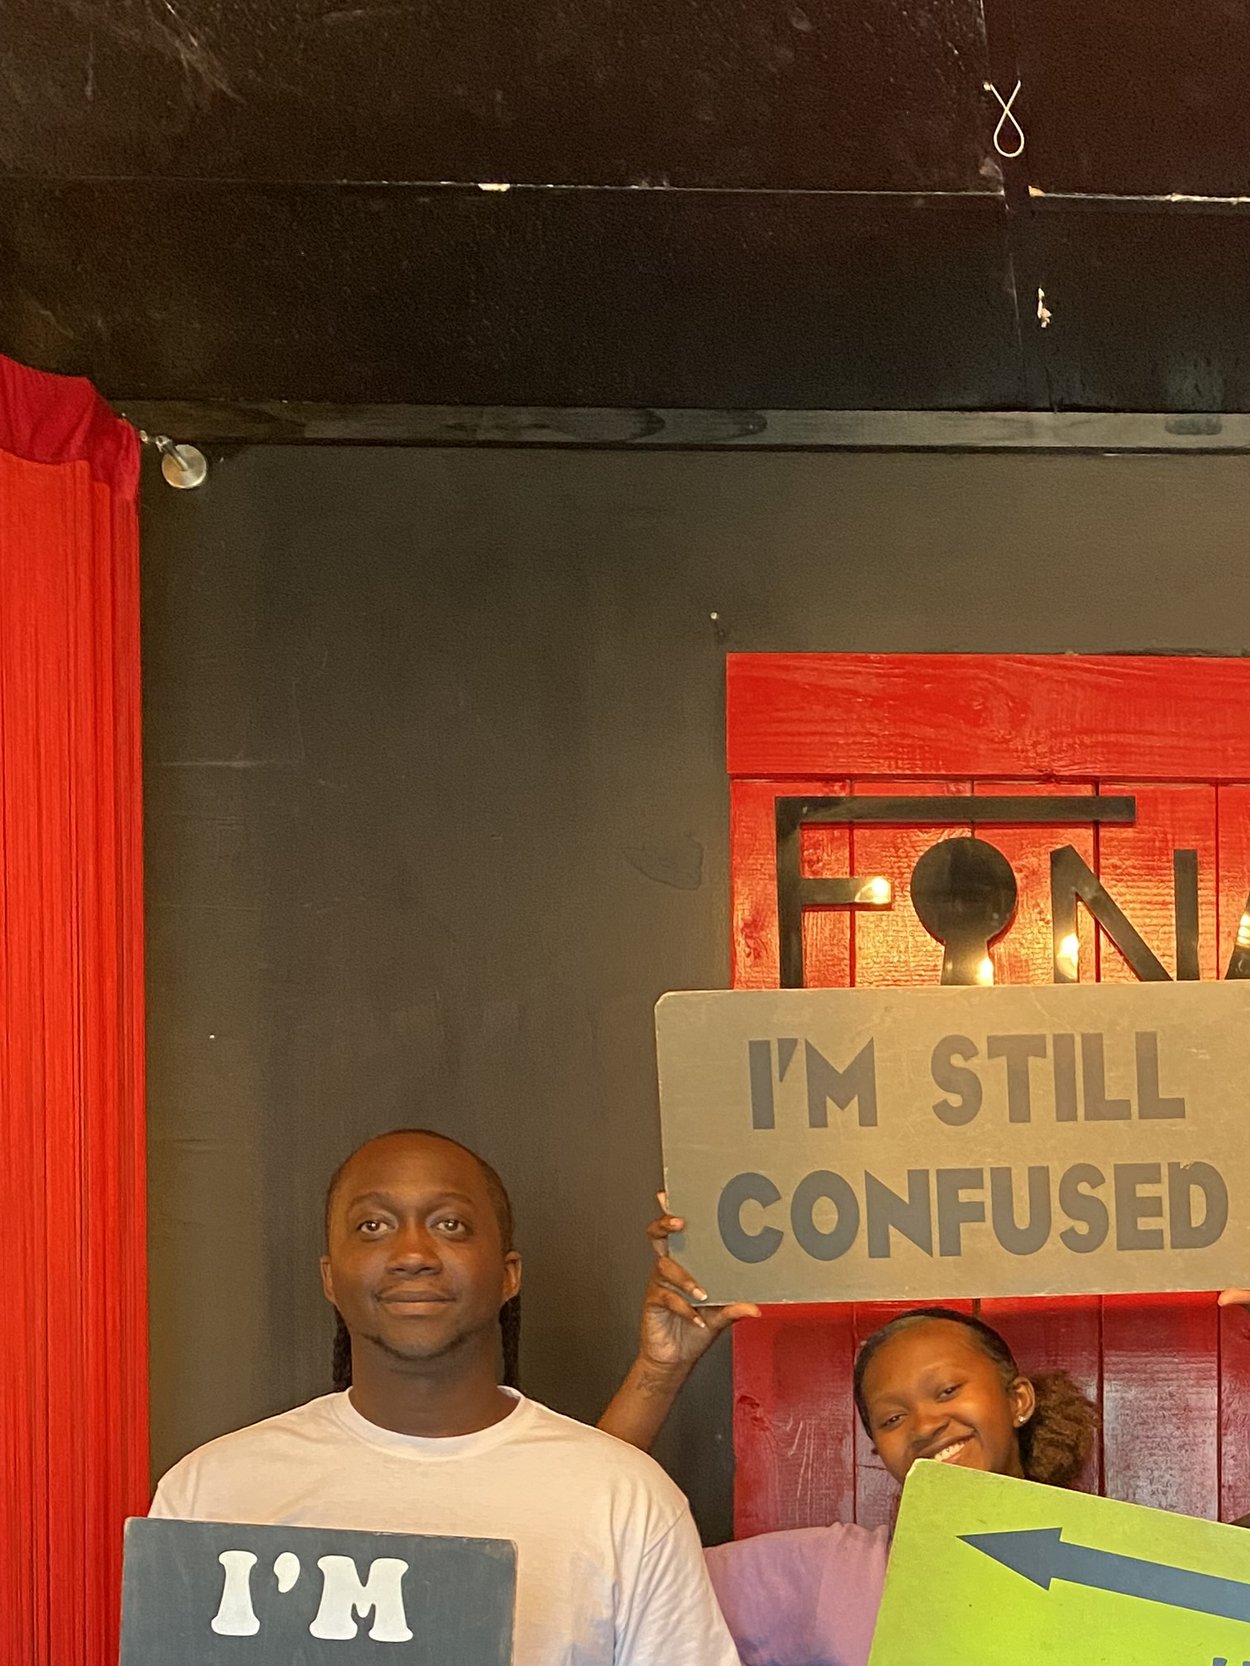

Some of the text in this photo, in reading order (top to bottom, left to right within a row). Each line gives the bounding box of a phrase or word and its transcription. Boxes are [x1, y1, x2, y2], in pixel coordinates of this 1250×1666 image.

[748, 1032, 1186, 1130] I'M STILL
[716, 1160, 1229, 1264] CONFUSED
[210, 1550, 414, 1643] I'M
